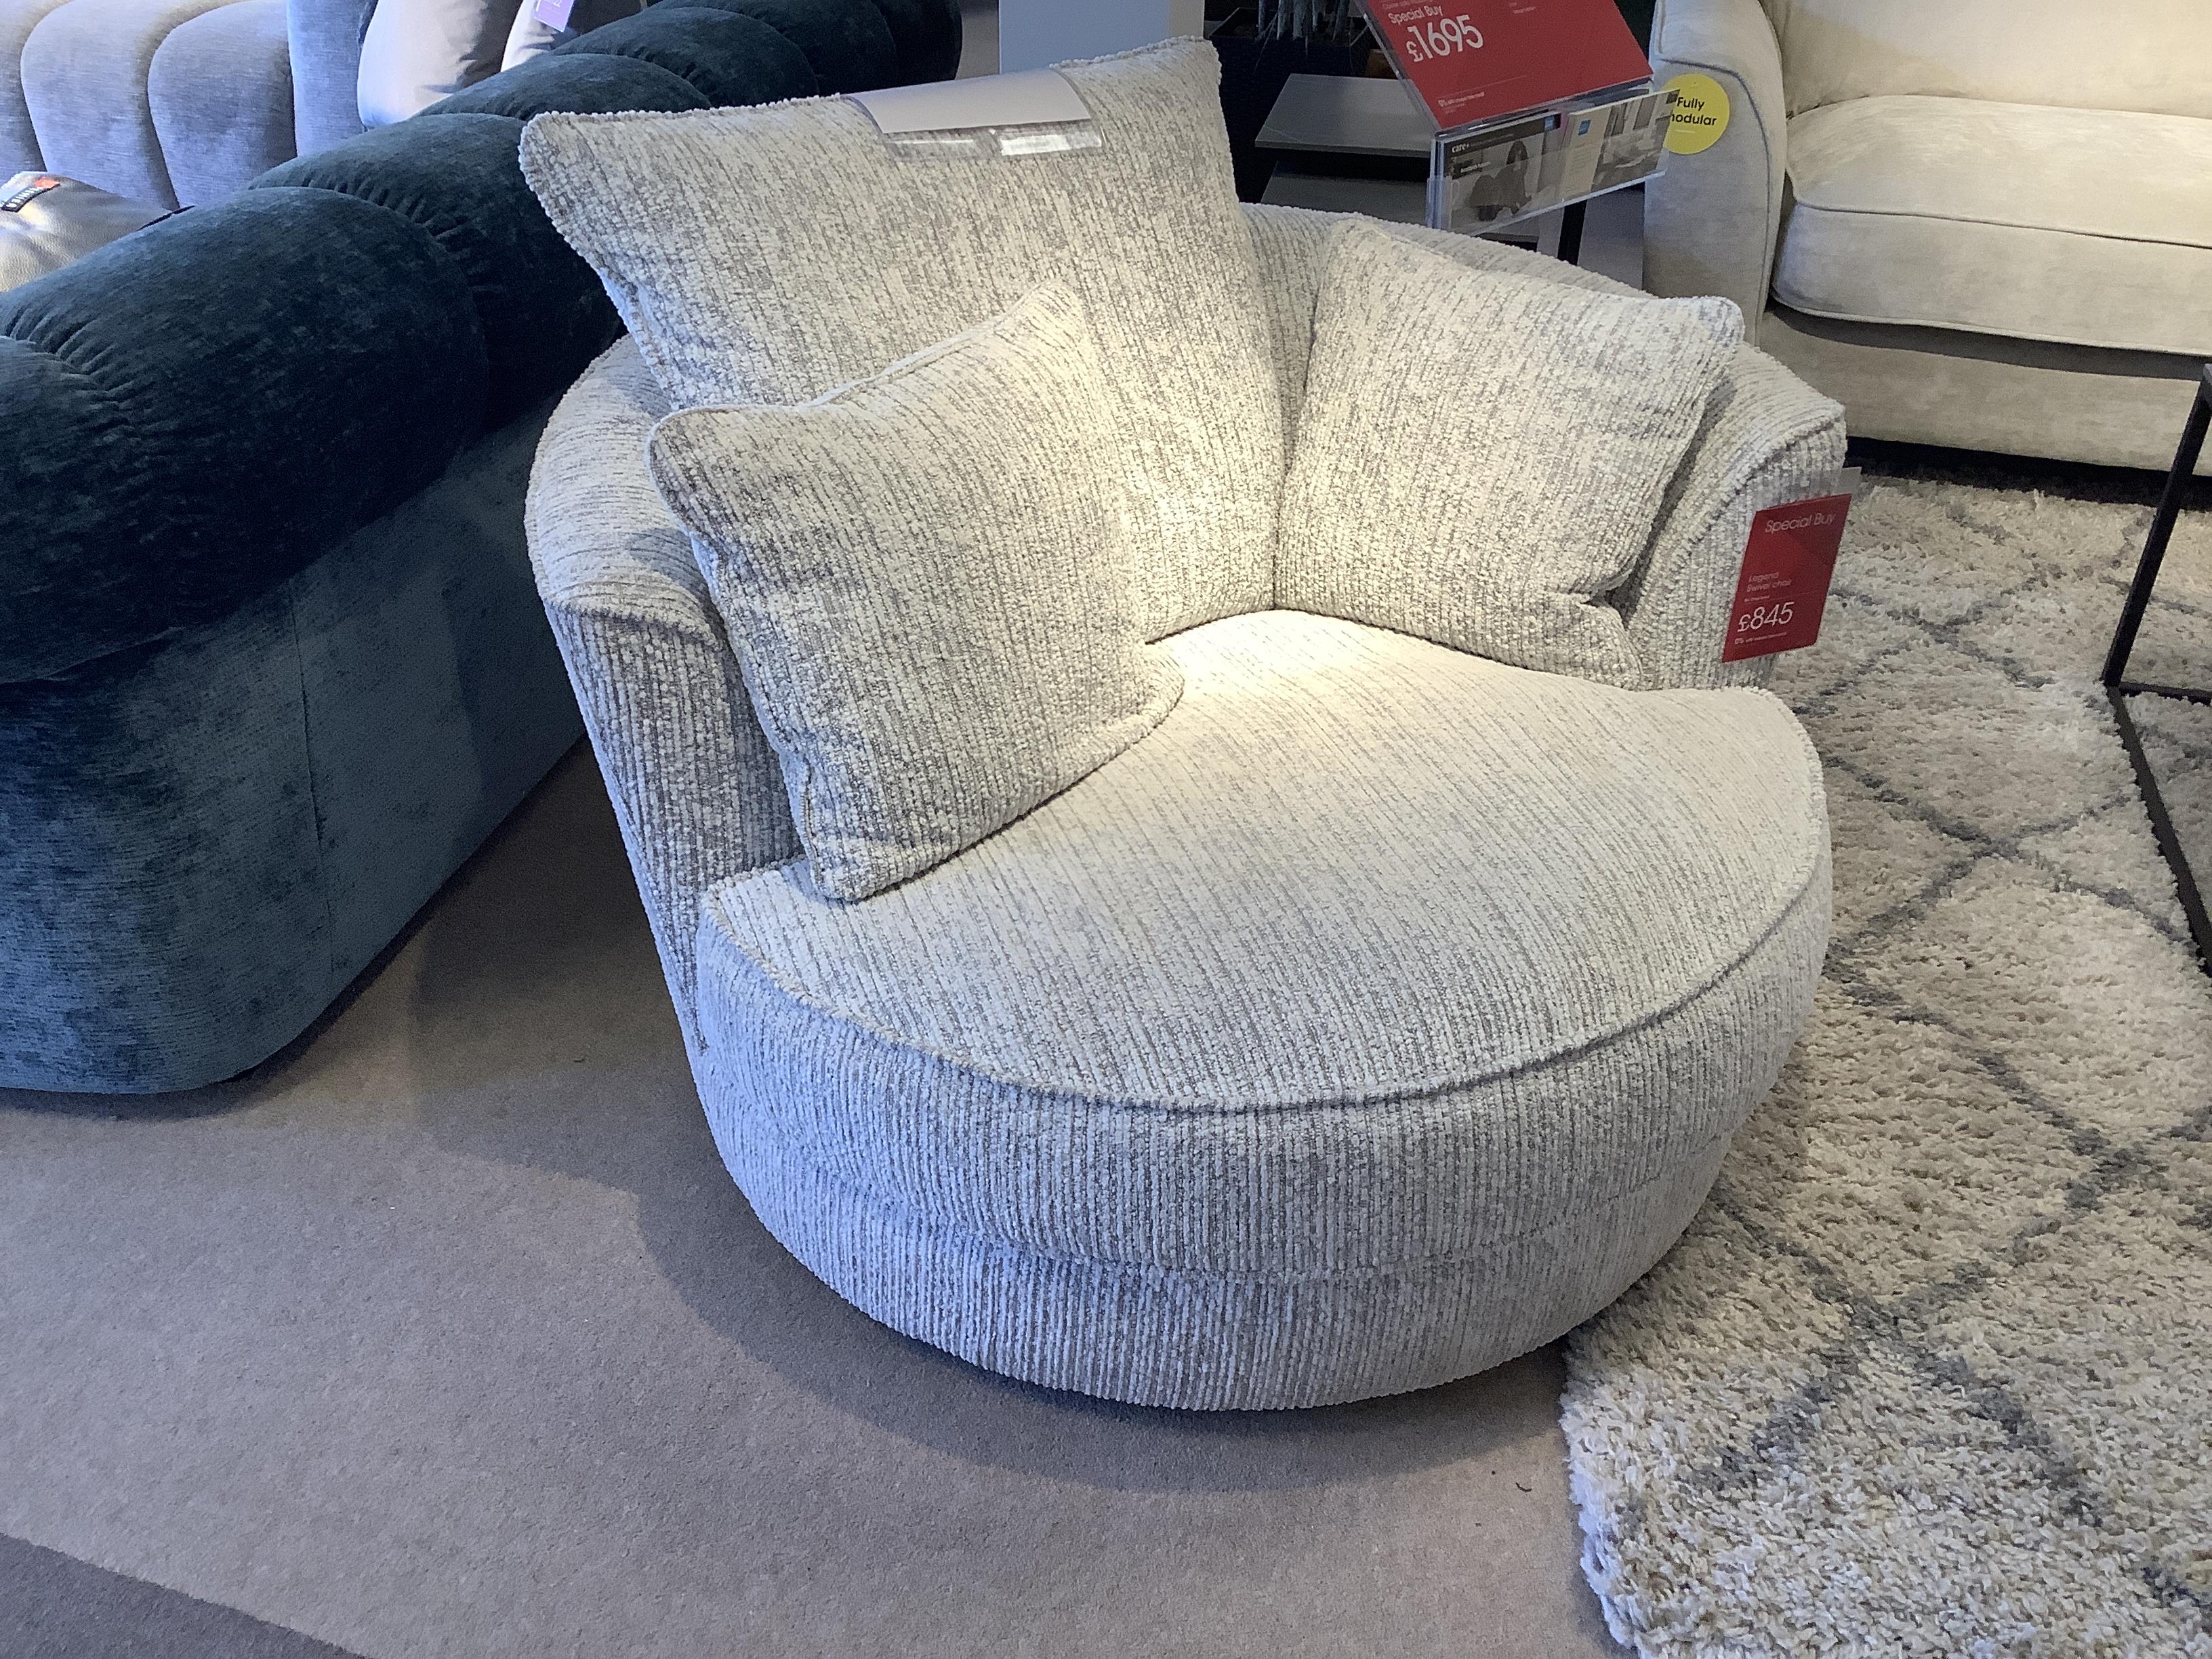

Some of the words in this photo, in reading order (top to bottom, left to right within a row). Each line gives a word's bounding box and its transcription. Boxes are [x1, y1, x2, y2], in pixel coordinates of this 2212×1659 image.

[1388, 8, 1425, 25] Special
[1424, 5, 1443, 16] Buy
[1406, 14, 1483, 62] £1695
[1677, 96, 1705, 111] Fully
[1765, 514, 1812, 534] Special
[1814, 512, 1836, 526] Buy
[1746, 583, 1771, 592] Swivel
[1771, 579, 1792, 588] chair
[1737, 601, 1795, 632] £845
